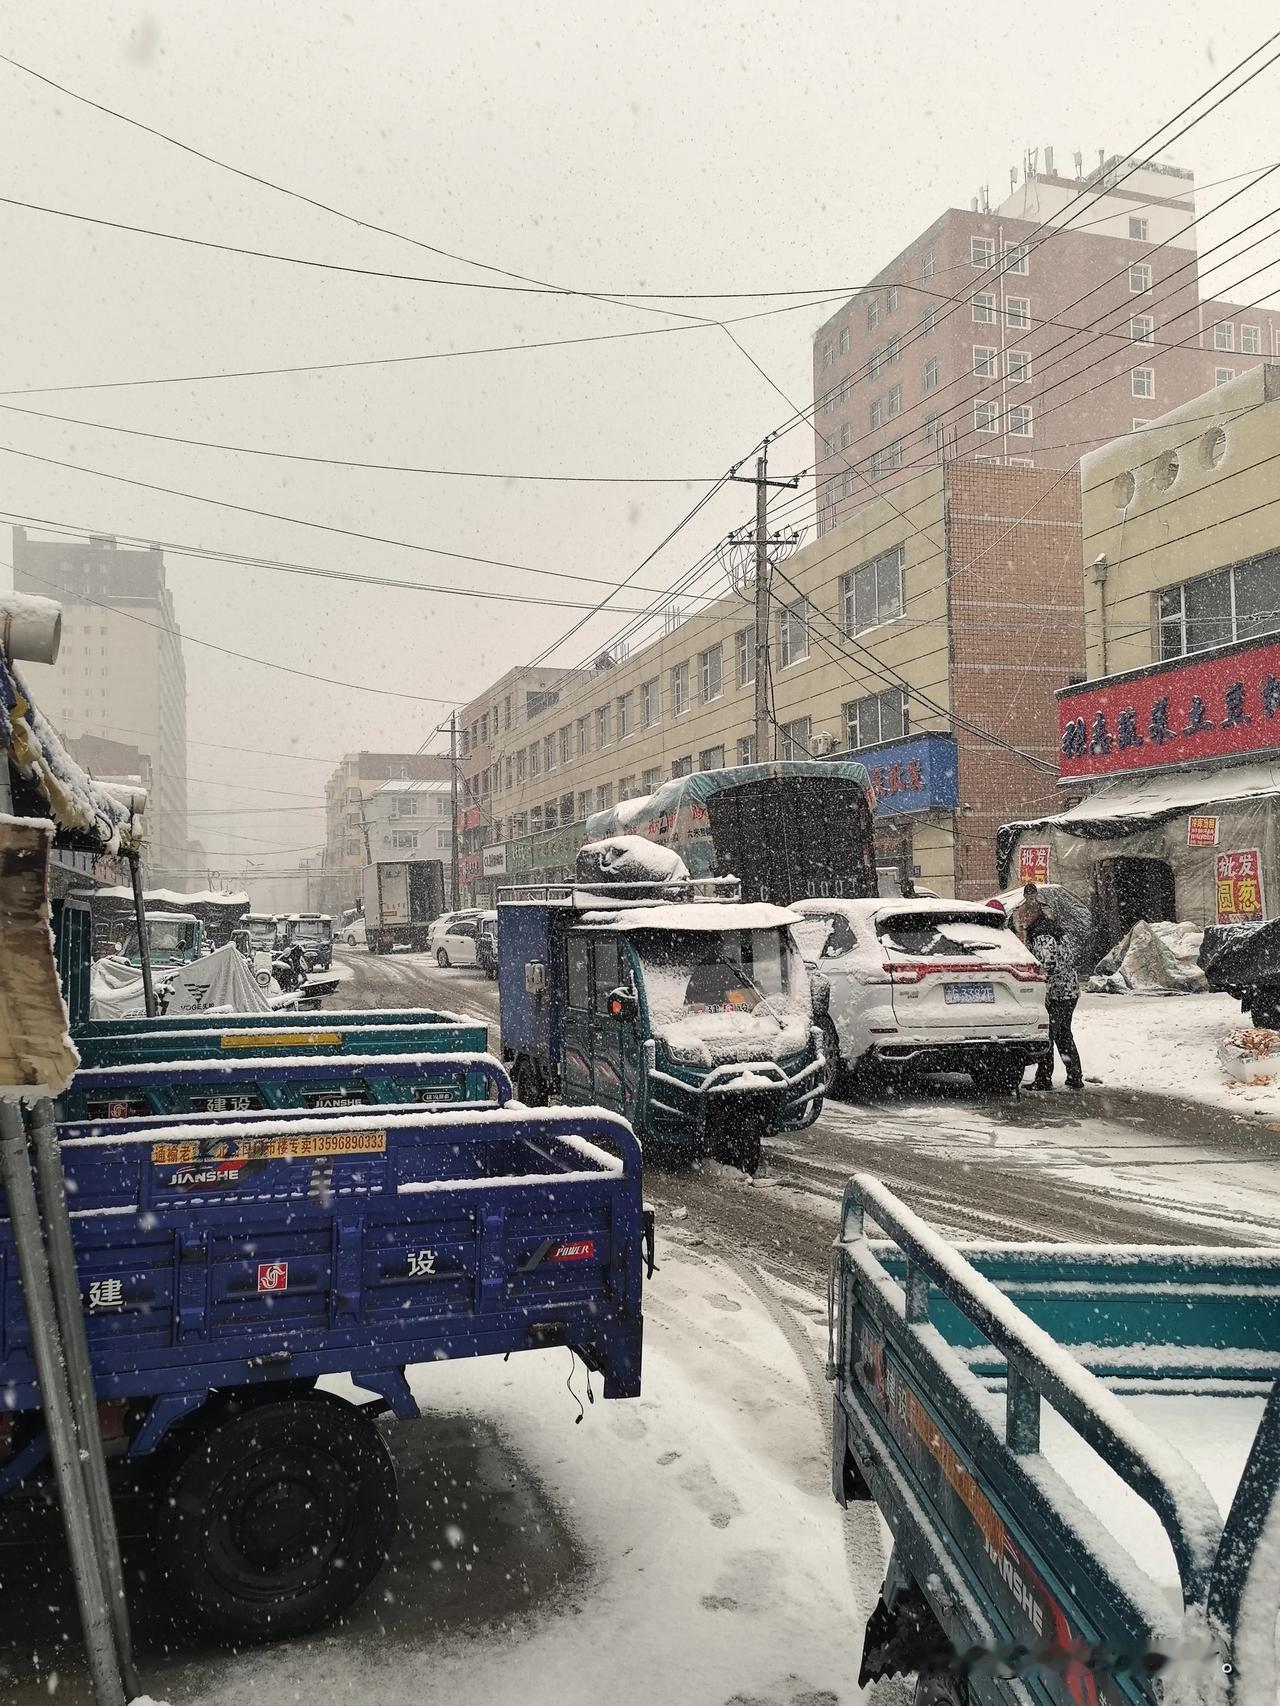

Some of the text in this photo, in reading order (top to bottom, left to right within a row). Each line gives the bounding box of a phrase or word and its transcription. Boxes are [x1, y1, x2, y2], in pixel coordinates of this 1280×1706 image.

[1022, 849, 1046, 866] 批发
[1219, 854, 1255, 877] 批发
[1218, 878, 1260, 913] 圆葱
[207, 1096, 251, 1113] 建设
[315, 1098, 362, 1108] JIANSHE
[168, 1169, 239, 1186] JIANSHE
[555, 1244, 590, 1257] POWER
[89, 1250, 436, 1309] 建 设
